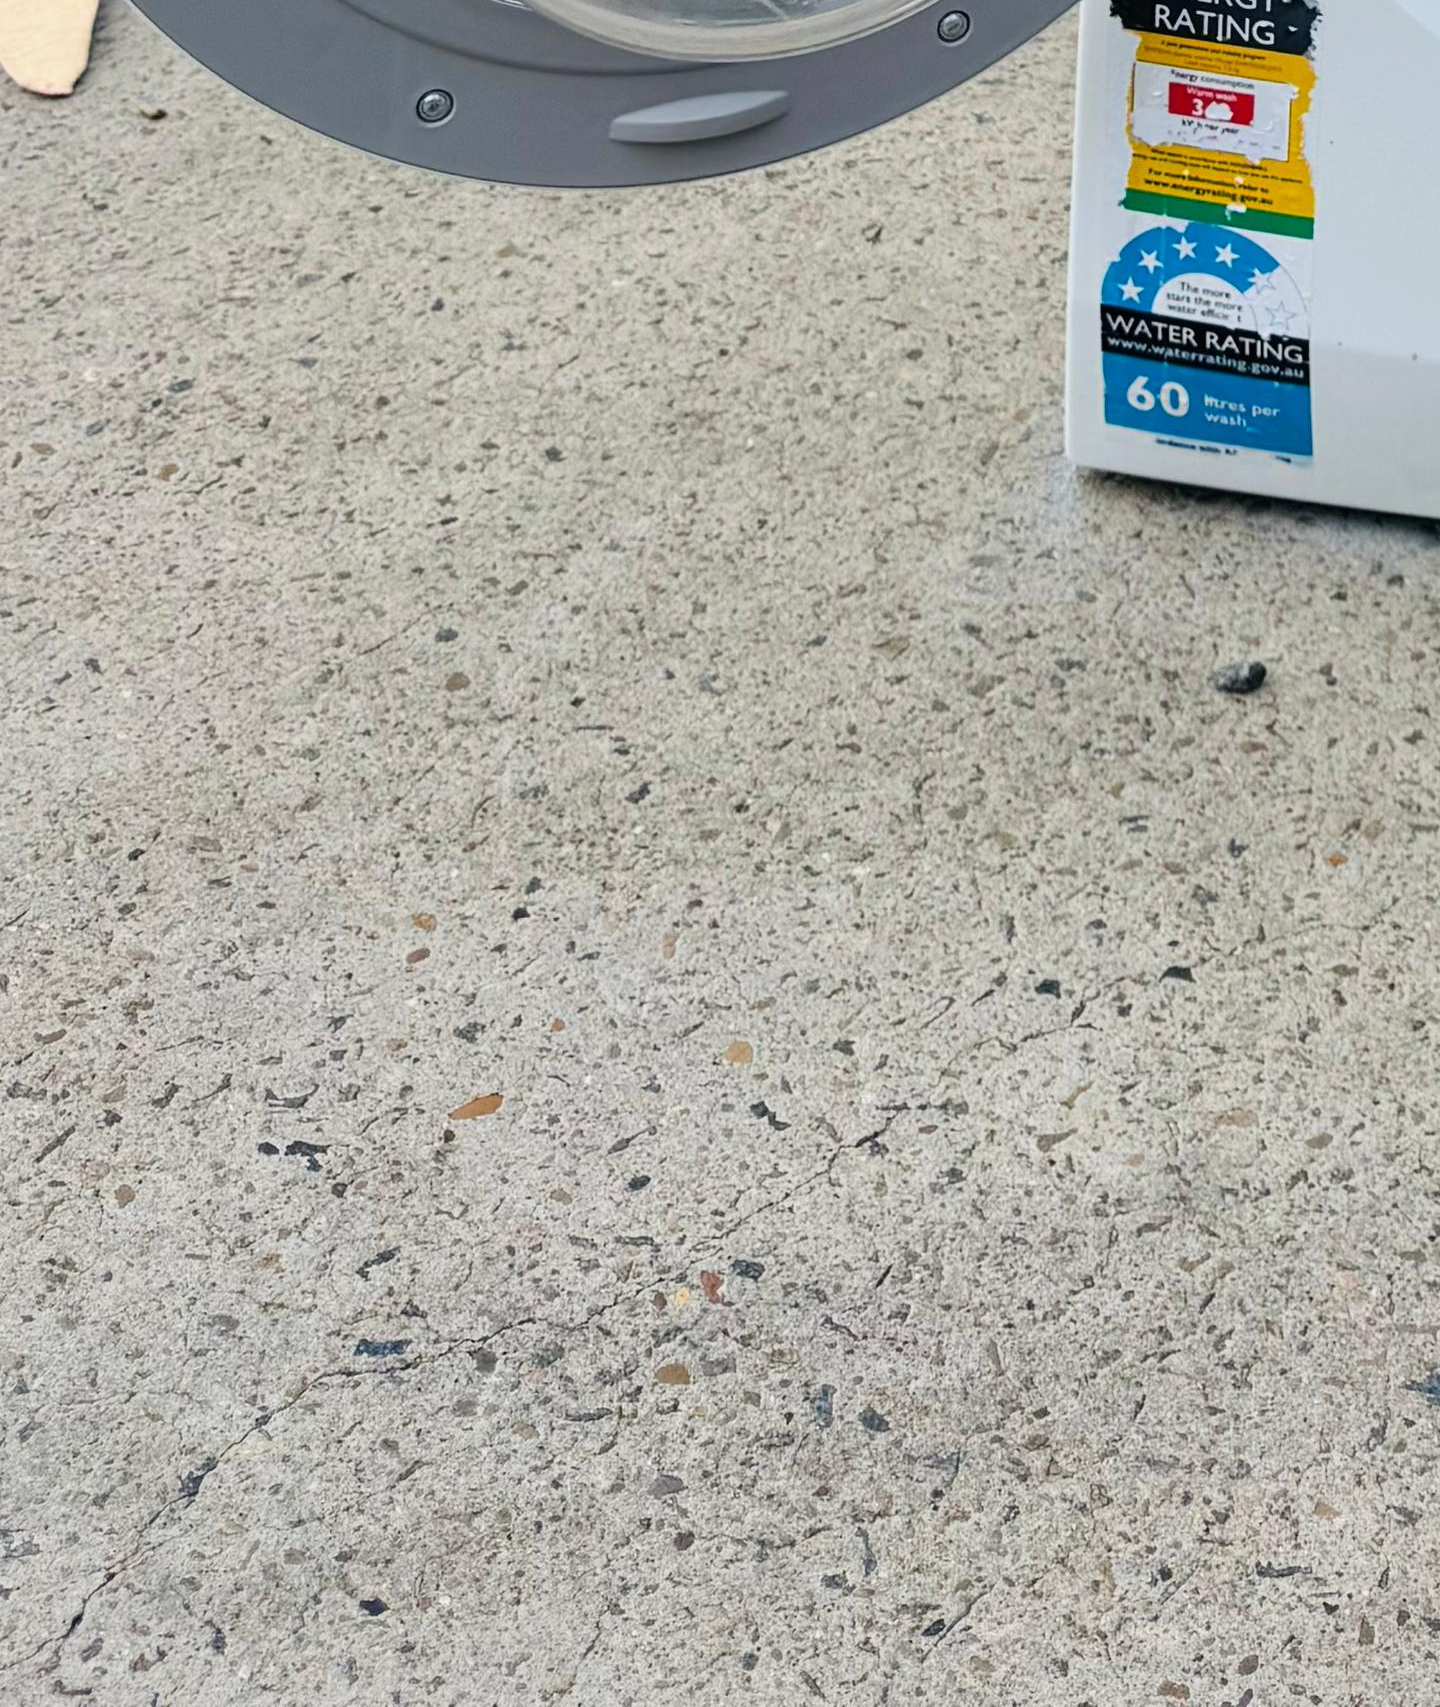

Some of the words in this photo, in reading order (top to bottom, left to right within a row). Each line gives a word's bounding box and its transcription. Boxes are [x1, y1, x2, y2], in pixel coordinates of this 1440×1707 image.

[1154, 4, 1275, 45] RATING
[1166, 291, 1192, 304] stars
[1194, 294, 1212, 306] the
[1180, 281, 1199, 294] The
[1202, 286, 1232, 299] more
[1167, 303, 1198, 316] water
[1106, 312, 1199, 347] WATER
[1205, 331, 1304, 364] RATING
[1106, 336, 1305, 379] www.waterrating.gov.au
[1126, 374, 1190, 418] 60
[1251, 403, 1281, 419] per
